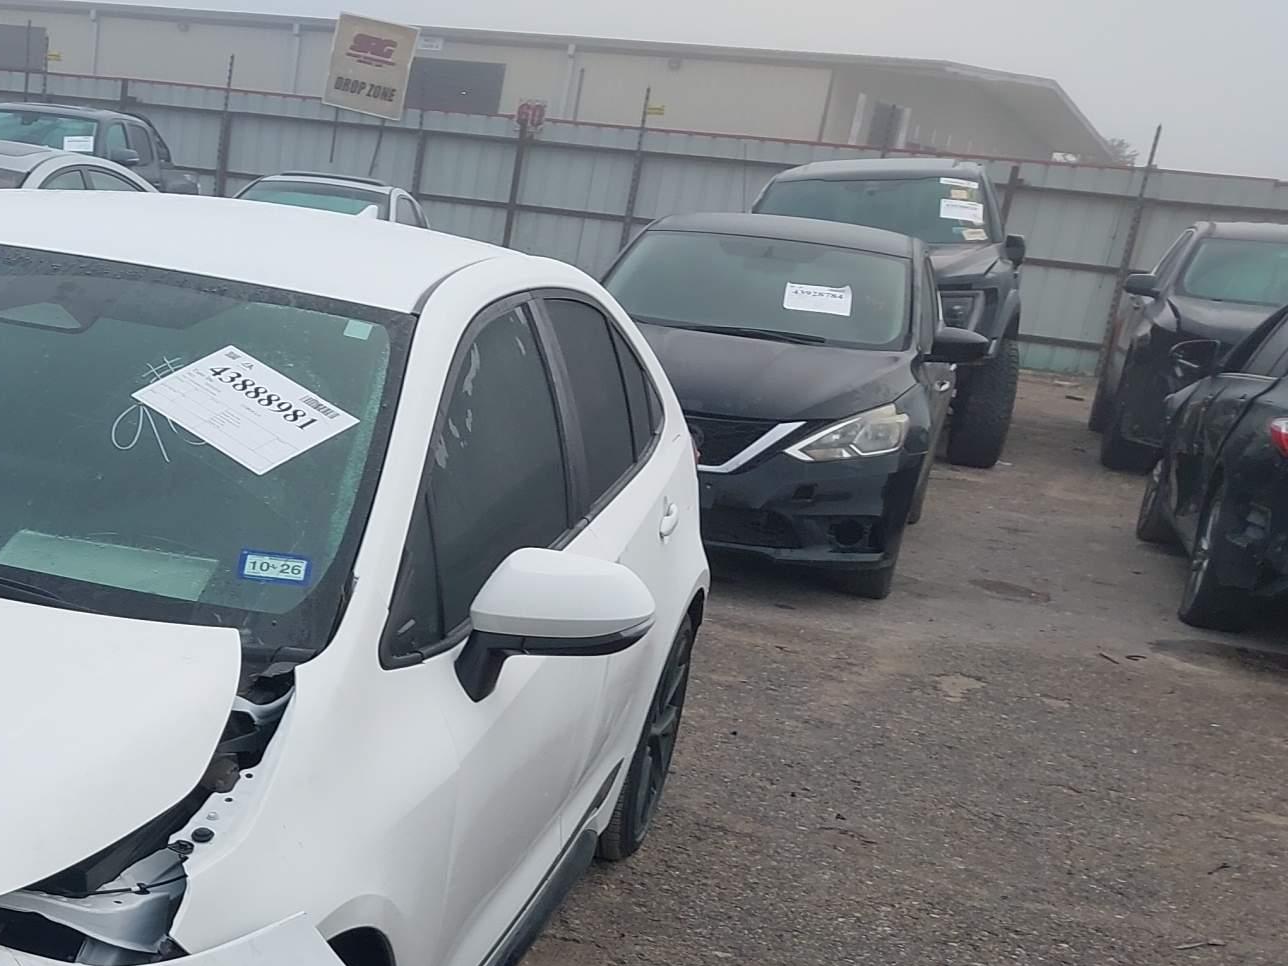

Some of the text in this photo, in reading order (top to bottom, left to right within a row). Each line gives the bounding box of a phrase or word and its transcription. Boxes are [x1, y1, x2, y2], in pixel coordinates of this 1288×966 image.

[334, 76, 397, 102] DROP ZONE
[209, 365, 318, 431] 43888981
